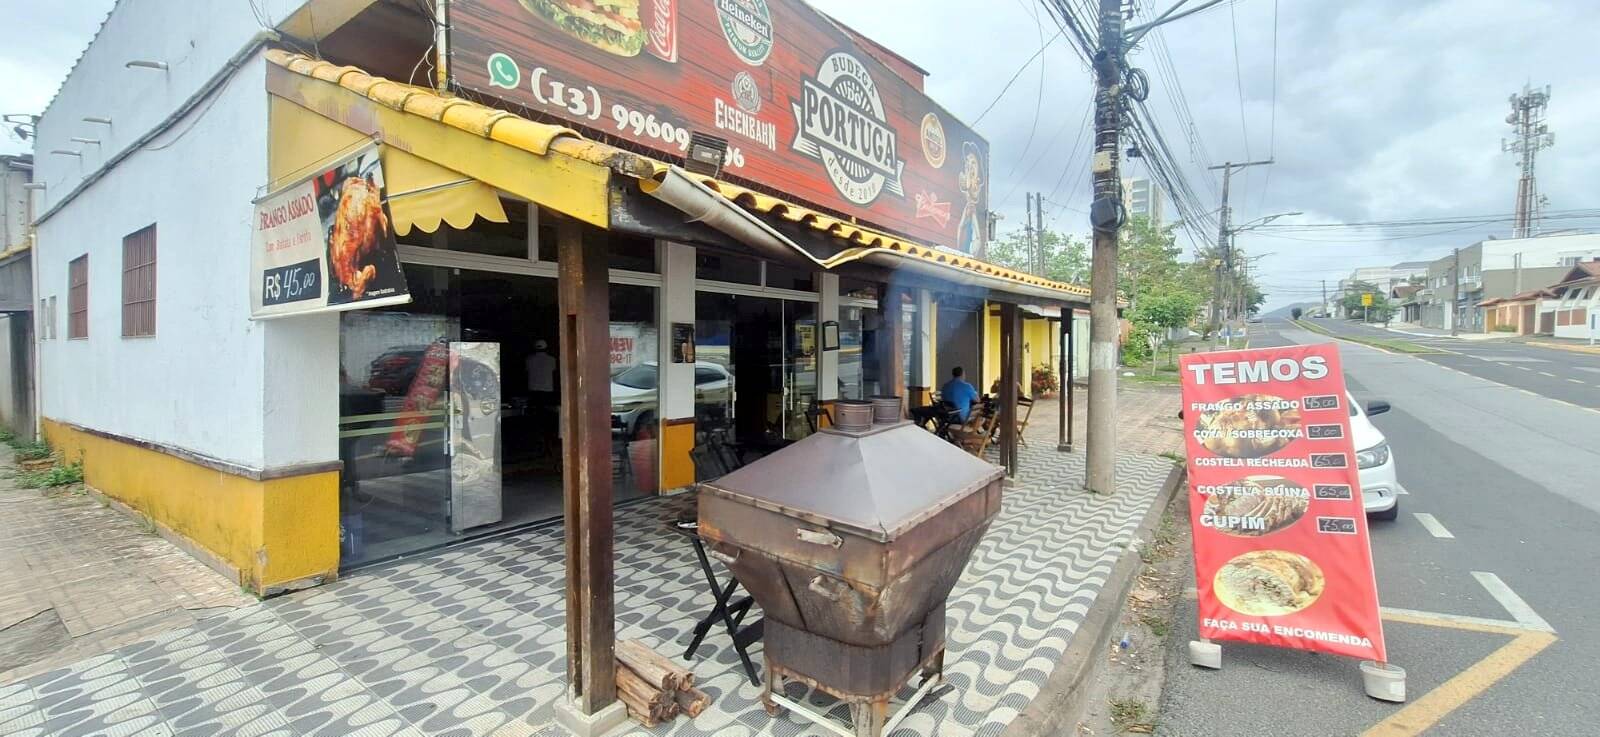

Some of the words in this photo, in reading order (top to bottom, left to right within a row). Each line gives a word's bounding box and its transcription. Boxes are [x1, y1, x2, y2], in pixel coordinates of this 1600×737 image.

[720, 0, 769, 37] Heineken
[831, 56, 875, 97] BUDEGA
[531, 67, 602, 120] (13)
[611, 104, 690, 151] 99609
[715, 98, 776, 151] EISENBAHN
[803, 85, 896, 170] PORTUGA
[827, 157, 854, 197] desde
[265, 273, 281, 300] R$
[283, 267, 315, 298] 45,00
[1188, 356, 1329, 385] TEMOS
[1191, 401, 1242, 411] FRANGO
[1246, 400, 1300, 411] ASSADO
[1232, 429, 1304, 439] SOBRECOXA
[1195, 457, 1244, 467] COSTELA
[1247, 458, 1309, 468] RECHEADA
[1196, 485, 1258, 497] COSTELA
[1199, 514, 1265, 530] CUPIM
[1203, 617, 1238, 632] FAÇA
[1241, 622, 1270, 634] SUA
[1273, 625, 1373, 648] ENCOMENDA
